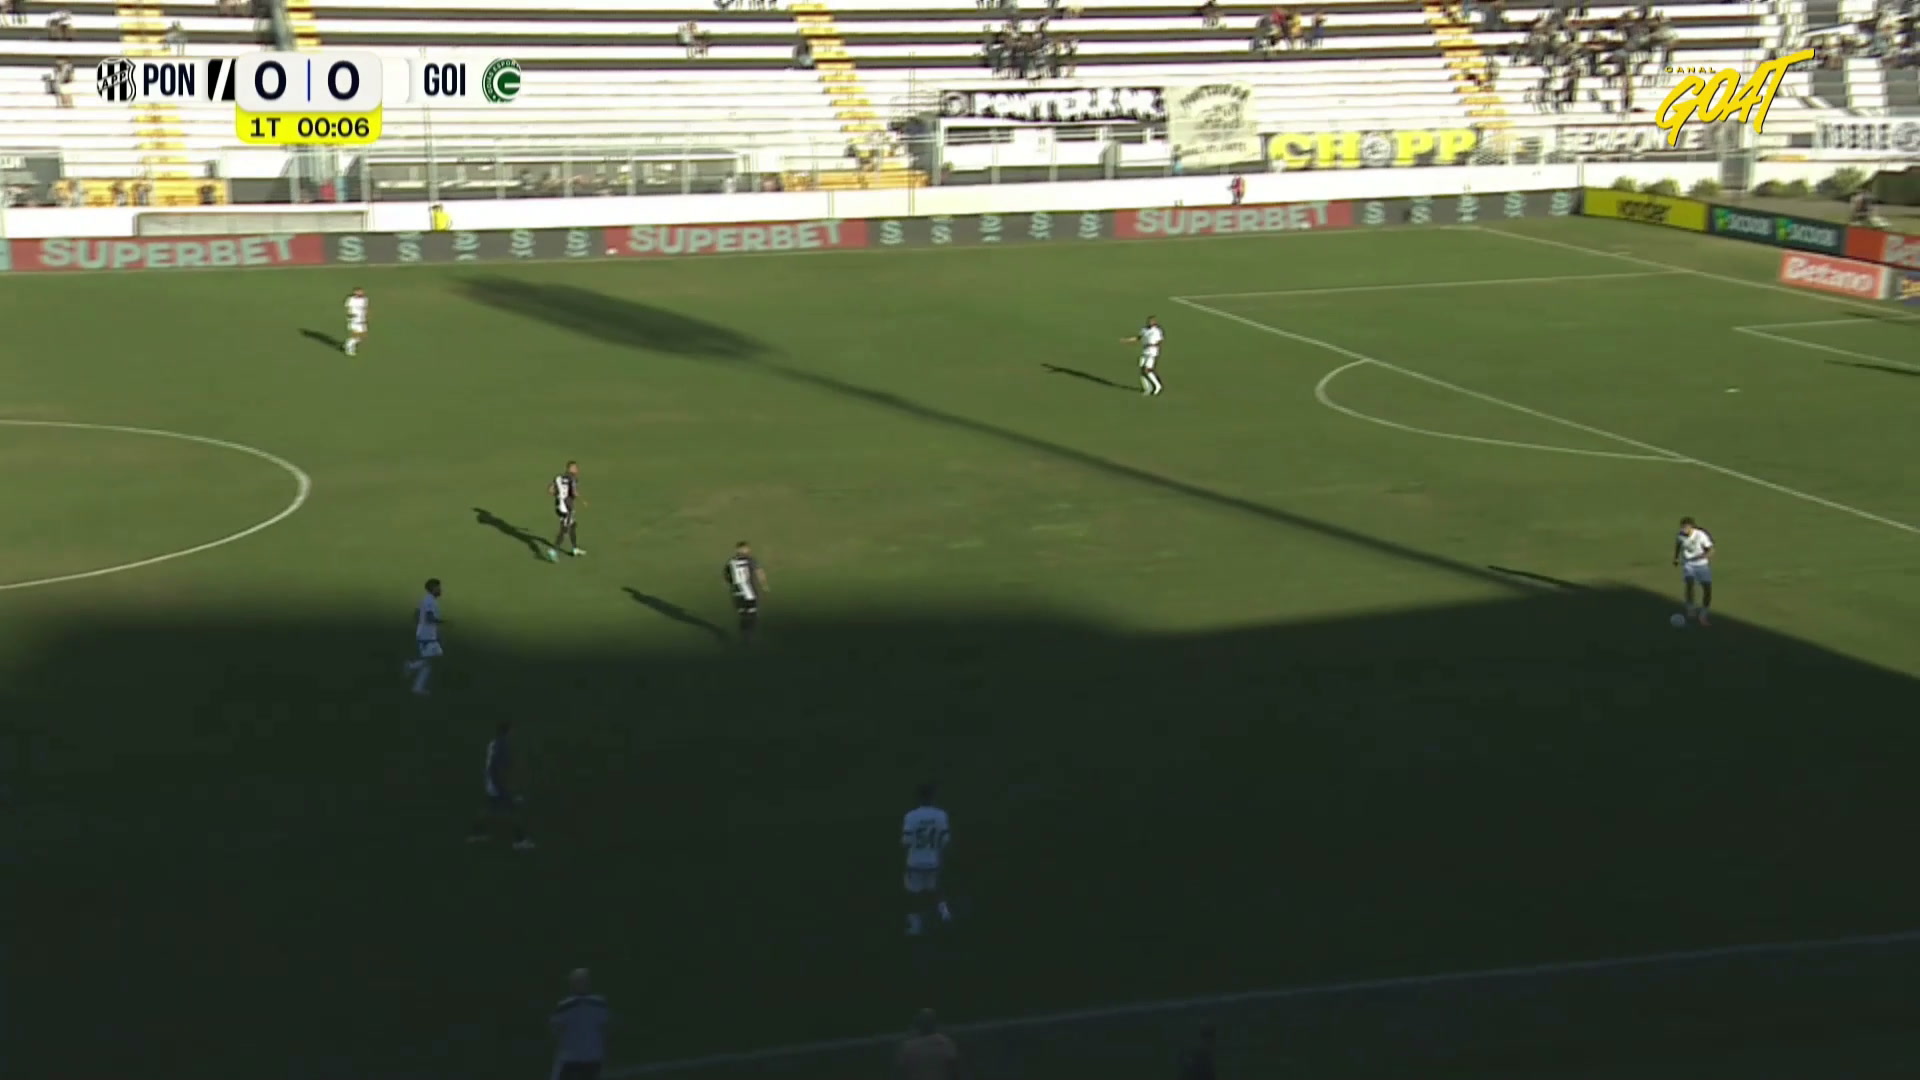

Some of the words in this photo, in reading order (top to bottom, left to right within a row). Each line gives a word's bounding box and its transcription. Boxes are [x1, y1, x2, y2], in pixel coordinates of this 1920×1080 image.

[1135, 200, 1329, 235] SUPERBET
[39, 234, 297, 269] SUPERBET
[627, 219, 843, 254] SUPERBET
